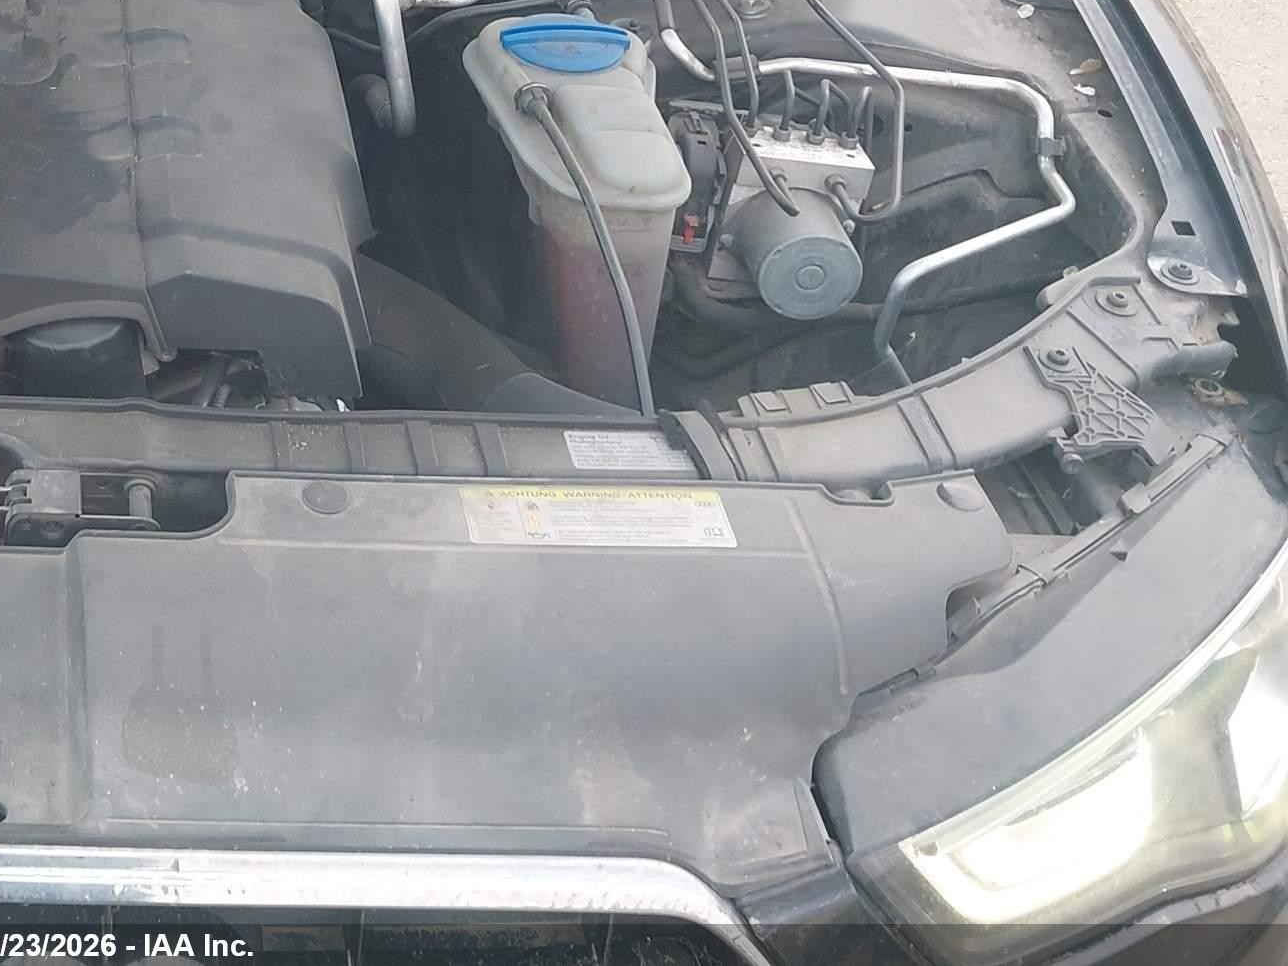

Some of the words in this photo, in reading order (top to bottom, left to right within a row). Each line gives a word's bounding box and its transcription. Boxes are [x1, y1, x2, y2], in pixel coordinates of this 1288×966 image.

[499, 490, 557, 499] ACHTUNG
[563, 490, 621, 499] WARNING
[627, 490, 693, 500] ATTENTION
